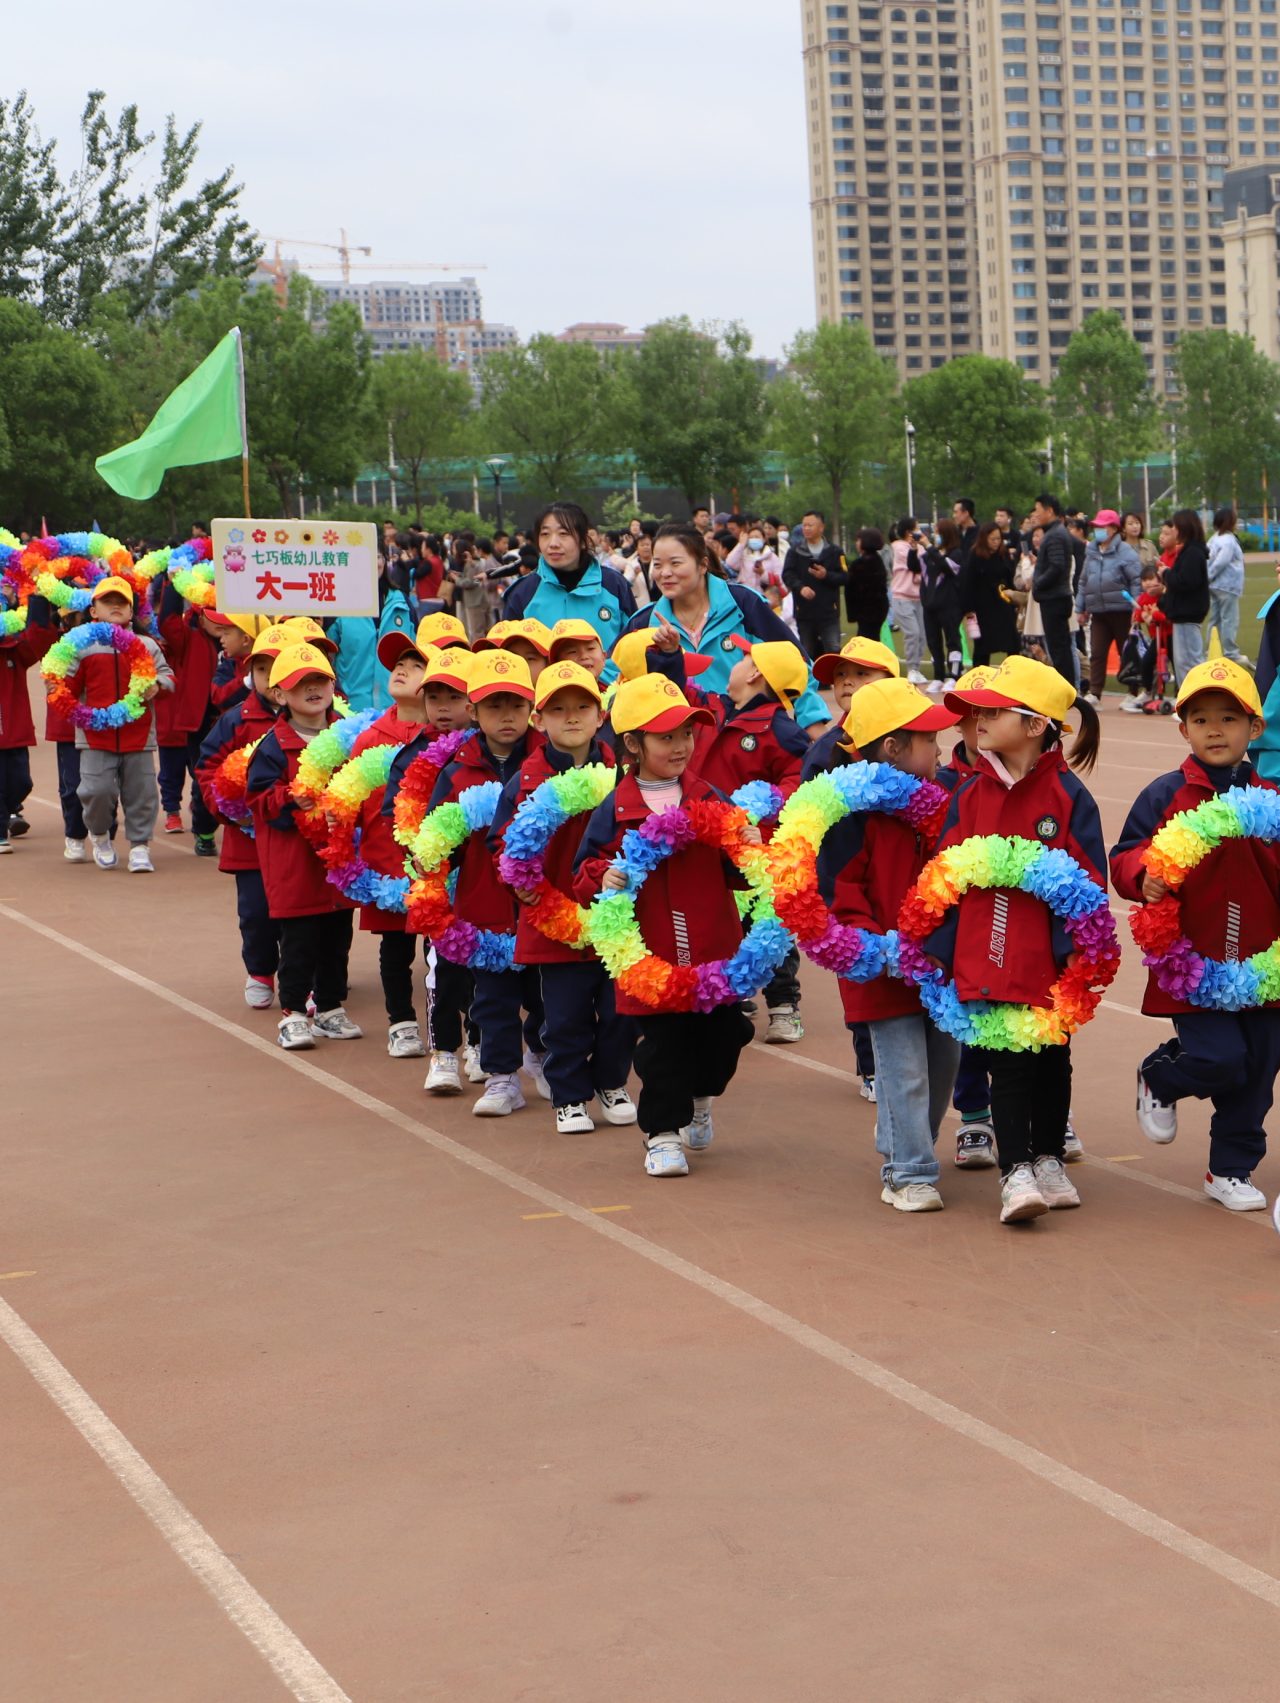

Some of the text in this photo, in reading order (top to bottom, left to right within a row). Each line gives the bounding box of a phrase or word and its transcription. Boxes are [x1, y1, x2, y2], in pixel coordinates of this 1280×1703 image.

[252, 550, 349, 567] 七巧板幼儿教育
[256, 571, 336, 602] 大一班
